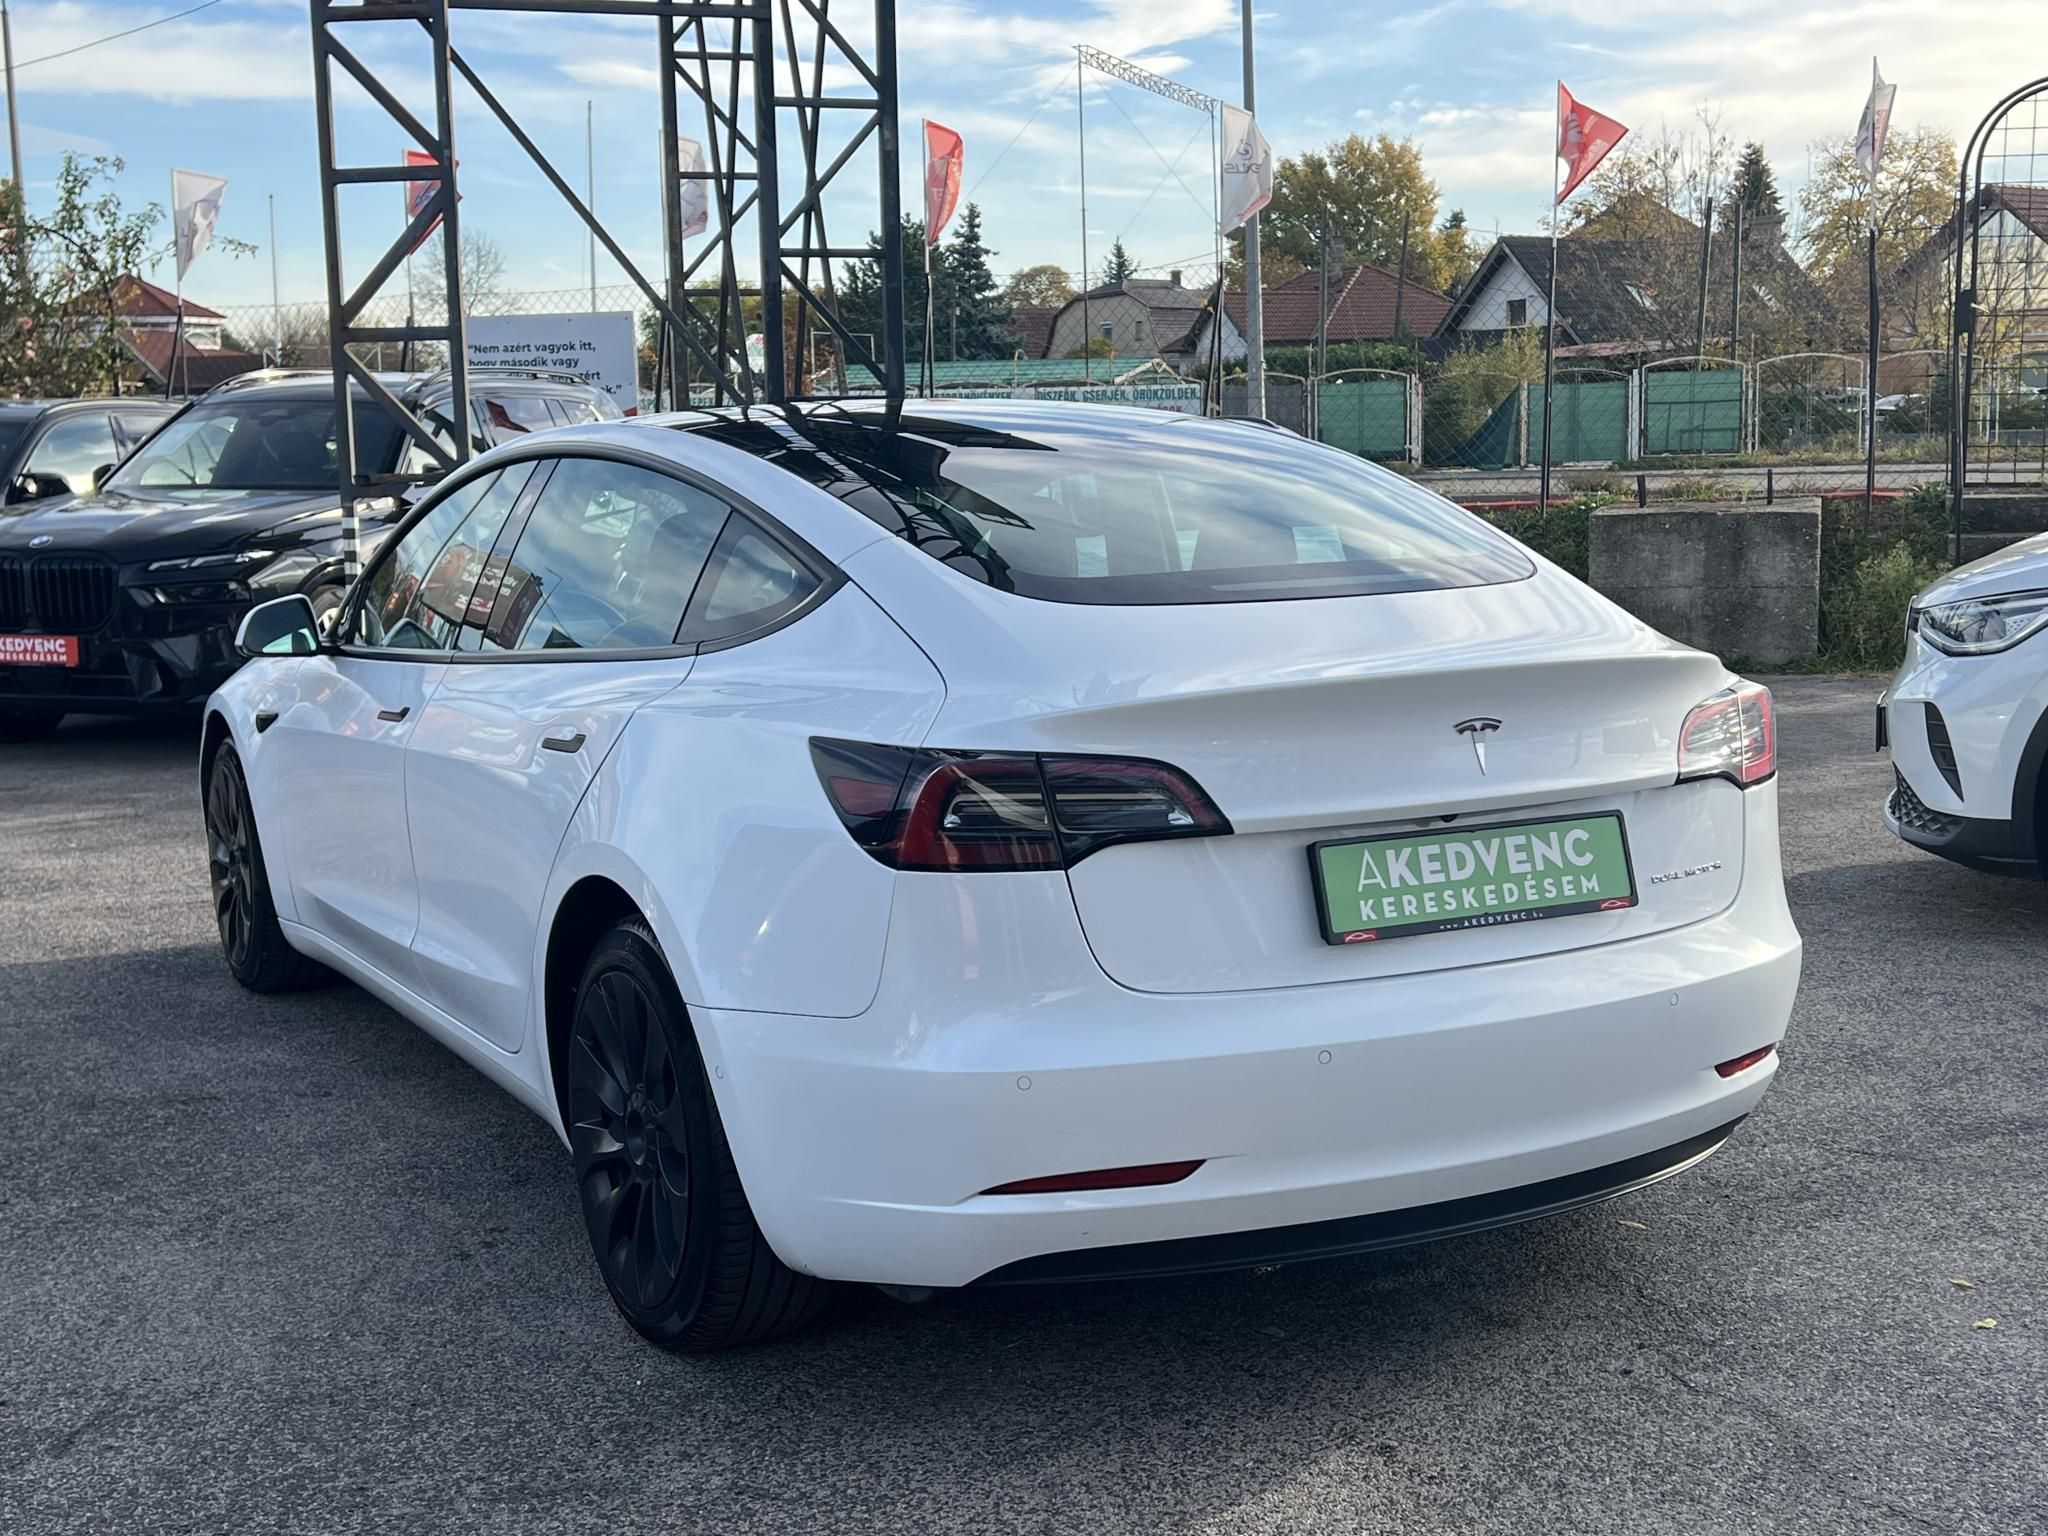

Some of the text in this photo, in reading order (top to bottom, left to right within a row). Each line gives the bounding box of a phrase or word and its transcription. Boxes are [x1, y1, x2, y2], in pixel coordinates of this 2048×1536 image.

[500, 356, 548, 367] második
[551, 359, 579, 368] vagy
[502, 342, 531, 353] azért
[534, 341, 576, 354] vagyok
[579, 340, 596, 352] itt,
[1357, 828, 1595, 893] AKEDVENC
[1359, 873, 1600, 922] KERESKEDÉSEM
